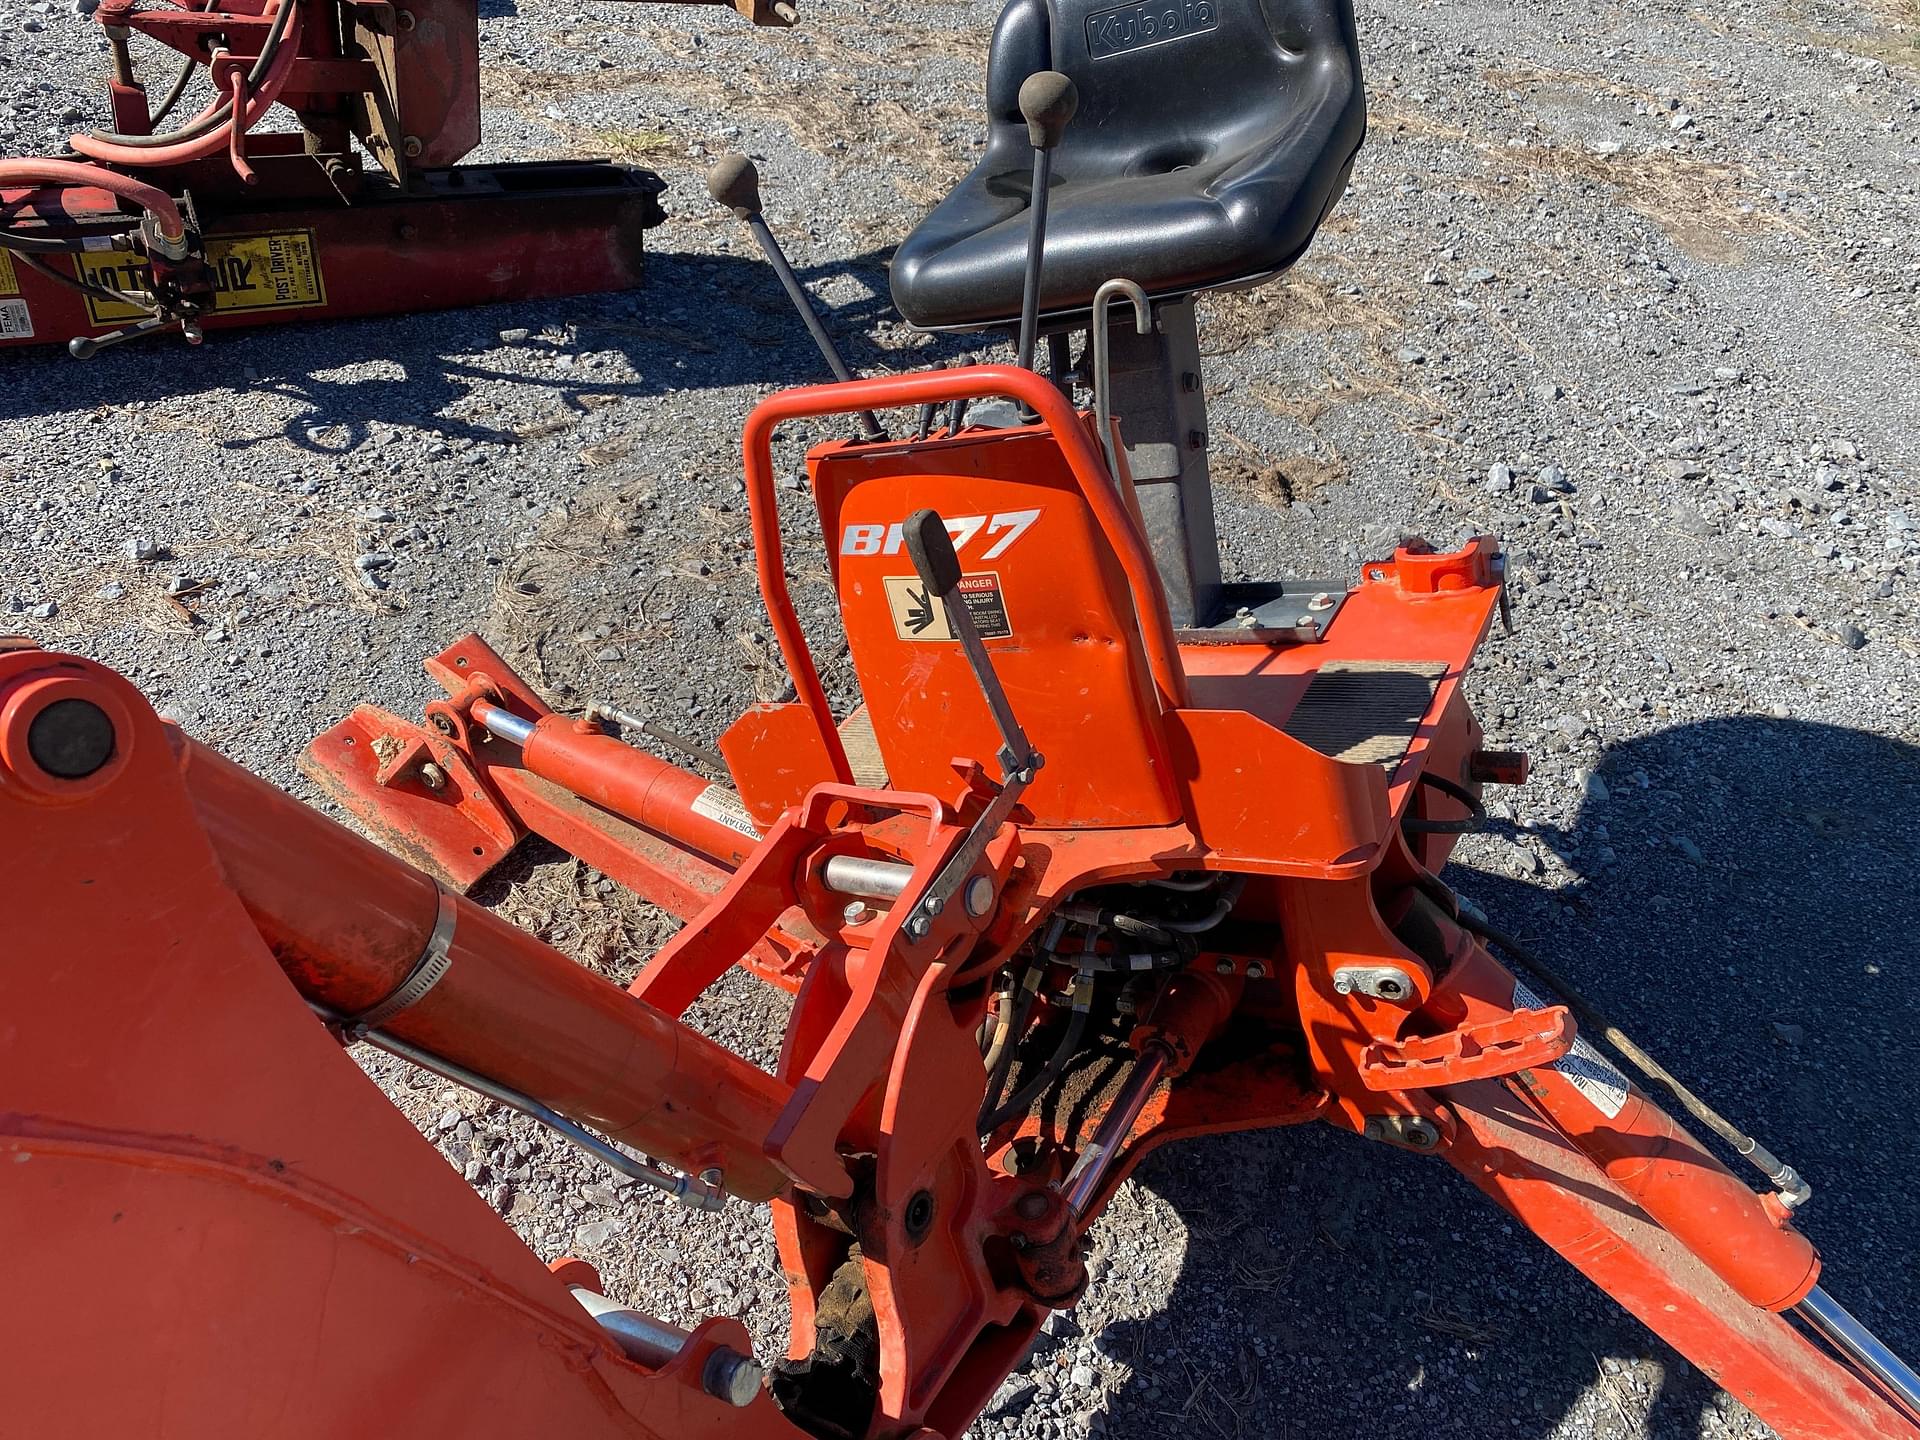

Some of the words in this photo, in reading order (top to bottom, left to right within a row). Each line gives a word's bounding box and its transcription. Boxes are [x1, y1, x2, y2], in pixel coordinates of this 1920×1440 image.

[1091, 0, 1215, 48] Kubota
[269, 240, 286, 273] DRIVER
[275, 277, 291, 300] POST
[0, 305, 13, 333] FEMA
[957, 579, 993, 589] ANGER
[718, 814, 763, 840] MPORTANT
[1553, 1057, 1588, 1090] IMPOR
